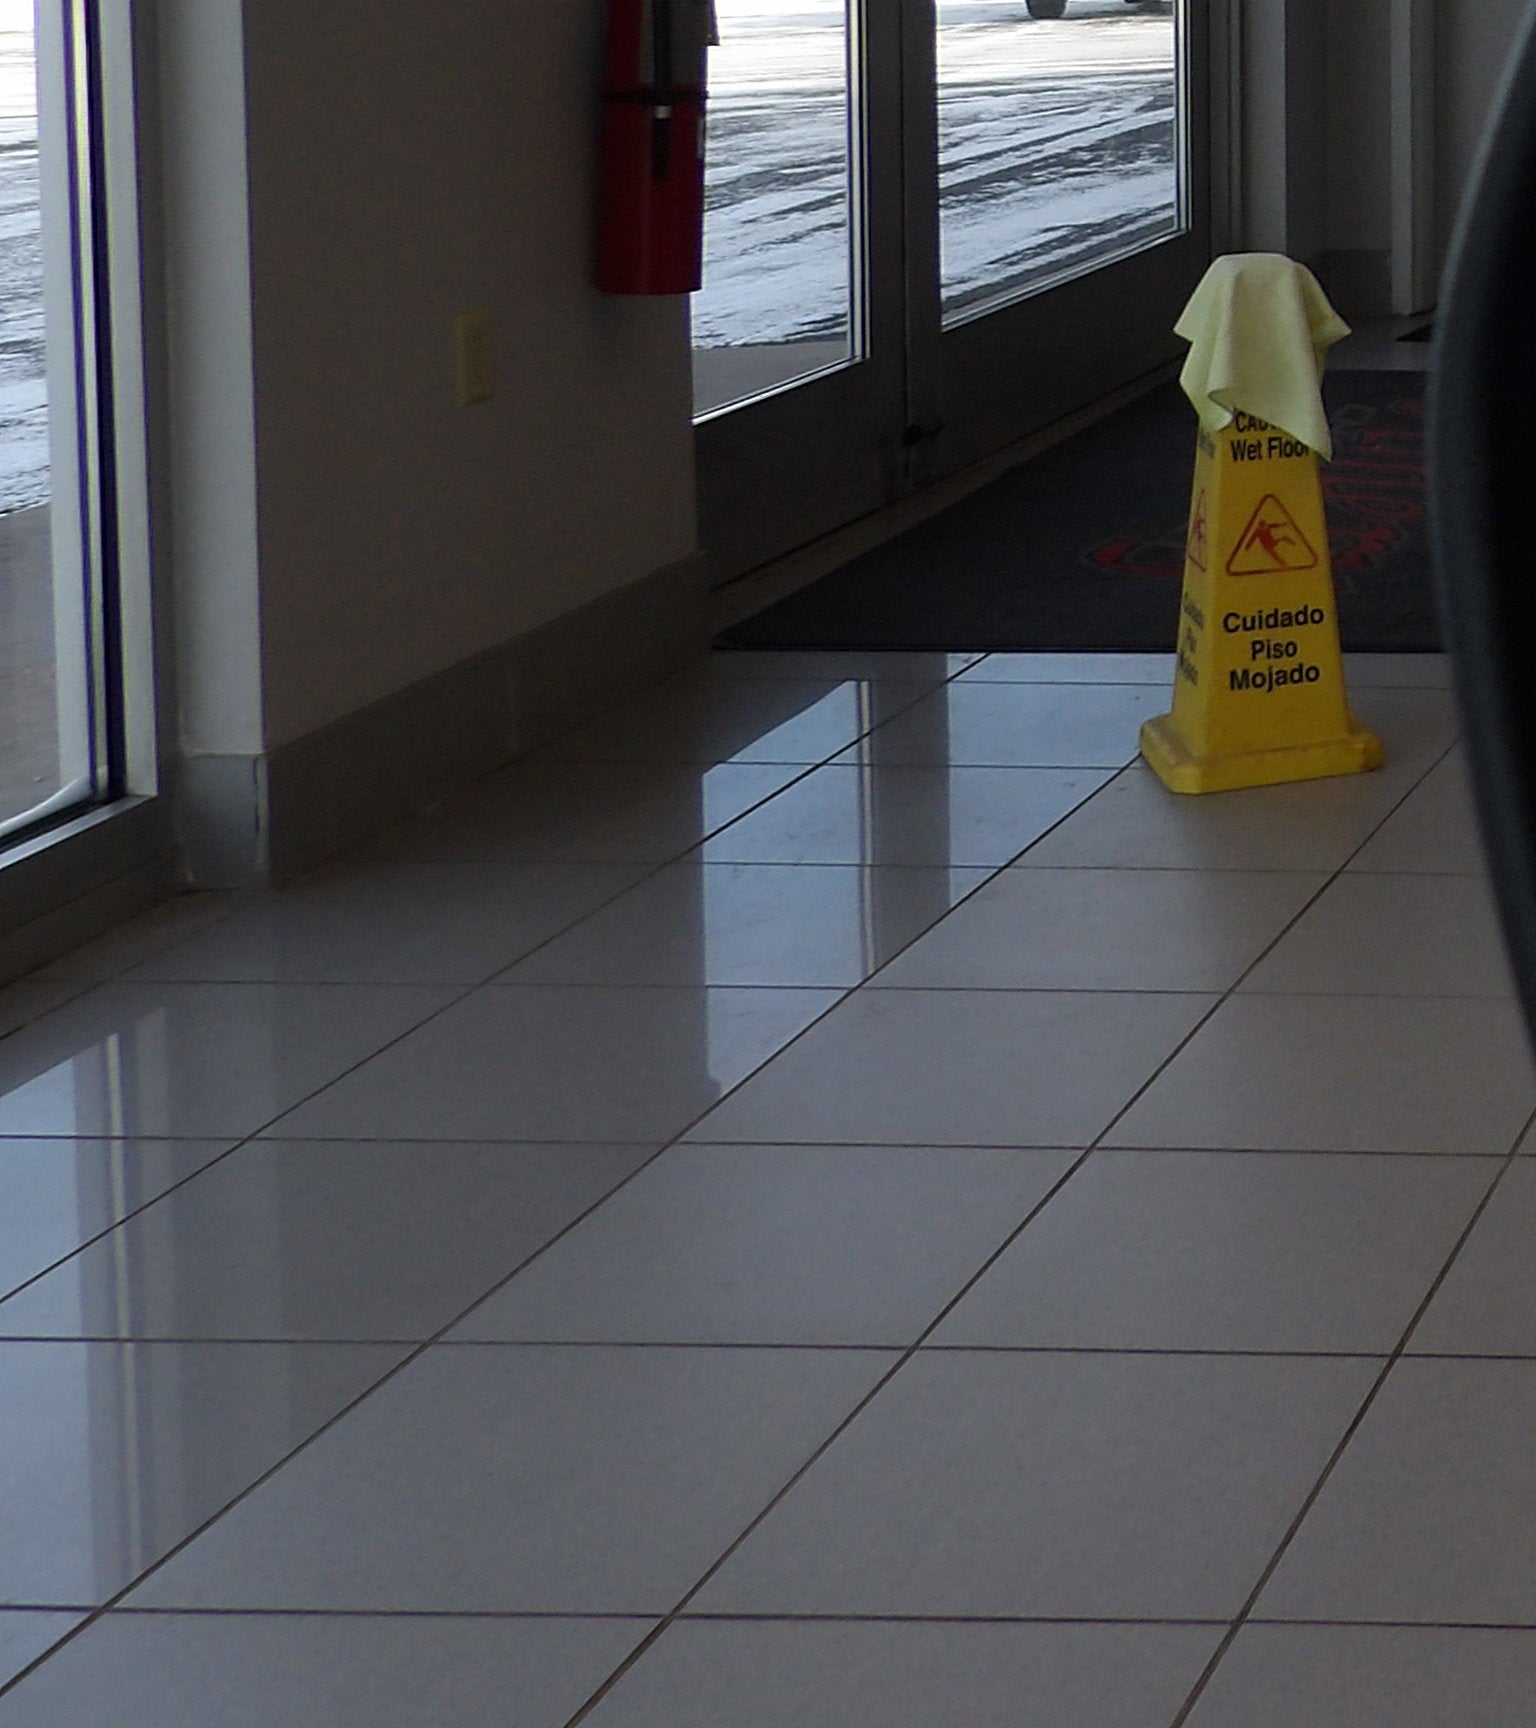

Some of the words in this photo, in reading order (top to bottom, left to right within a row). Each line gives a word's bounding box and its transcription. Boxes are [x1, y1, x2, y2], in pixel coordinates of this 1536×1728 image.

[1231, 438, 1263, 461] Wet
[1222, 604, 1325, 633] Cuidado
[1251, 638, 1298, 660] Piso
[1230, 663, 1320, 692] Mojado
